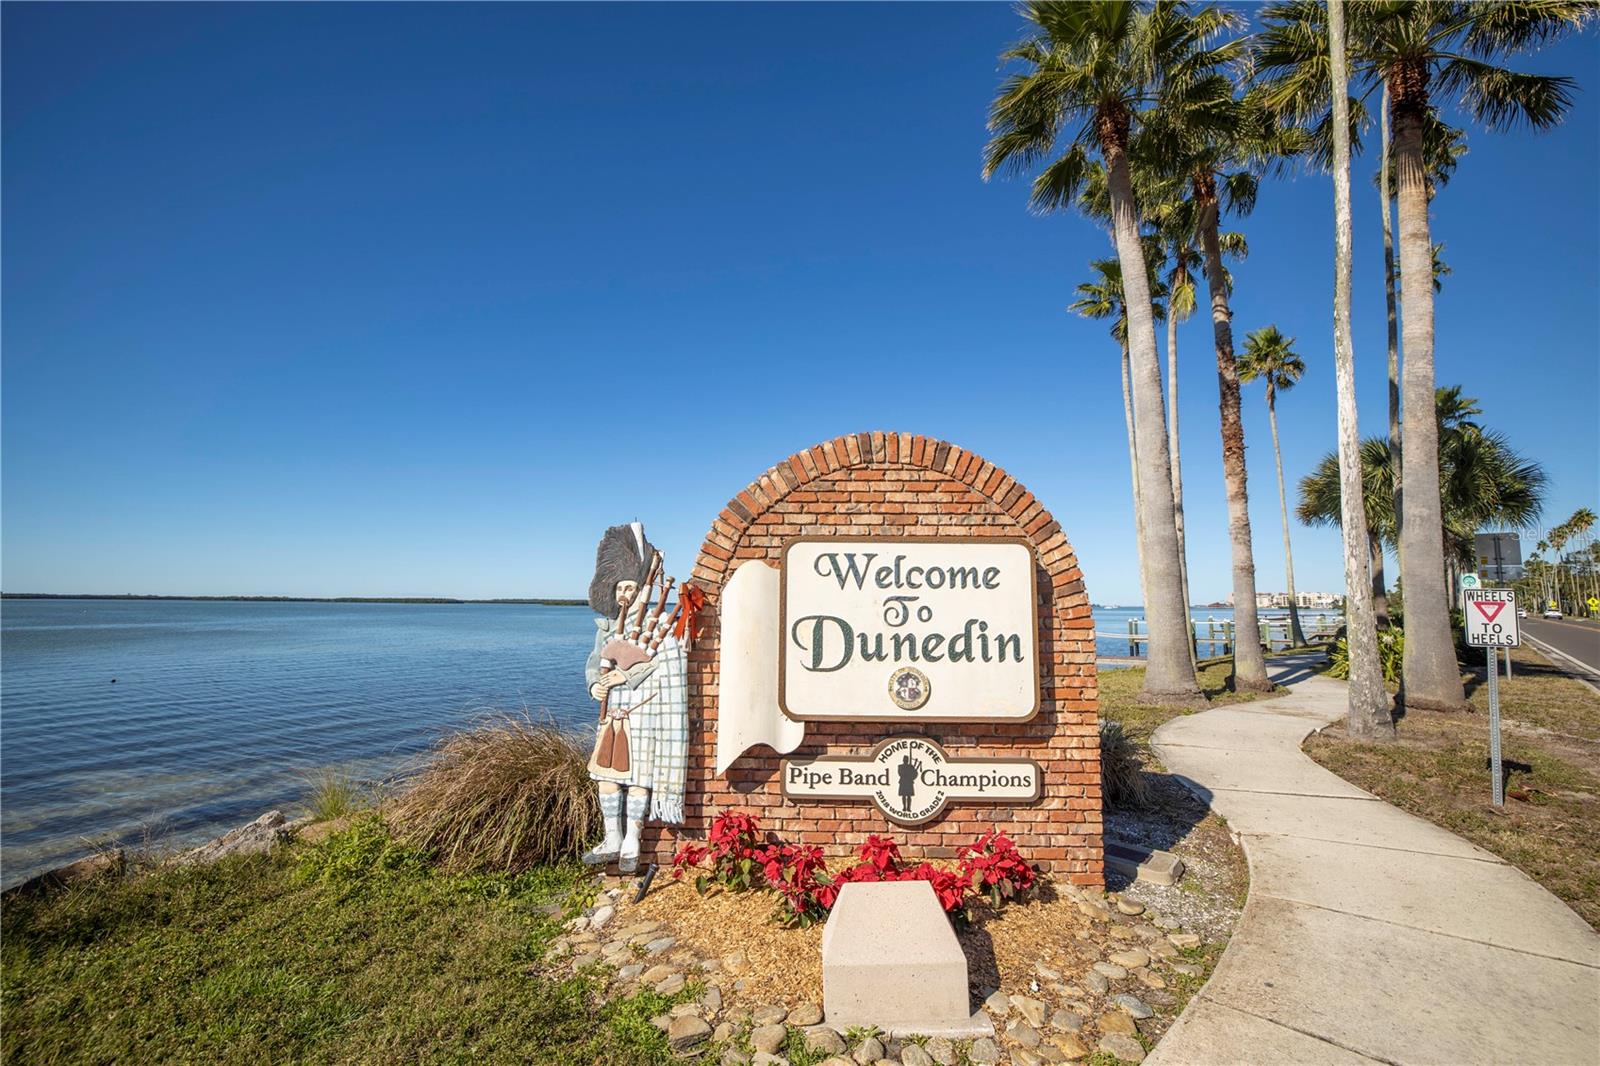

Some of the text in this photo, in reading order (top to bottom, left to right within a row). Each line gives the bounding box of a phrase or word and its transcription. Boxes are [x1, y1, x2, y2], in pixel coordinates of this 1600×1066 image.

[813, 552, 1001, 591] Welcome
[1466, 591, 1514, 603] WHEELS
[883, 595, 933, 628] To
[1472, 633, 1514, 645] HEELS
[1481, 622, 1503, 634] TO
[791, 614, 1025, 673] Dunedin
[878, 740, 942, 765] HOME OF THE
[789, 767, 1032, 791] Pipe Band Champions
[889, 806, 919, 819] WORLD
[919, 797, 942, 817] GRADE
